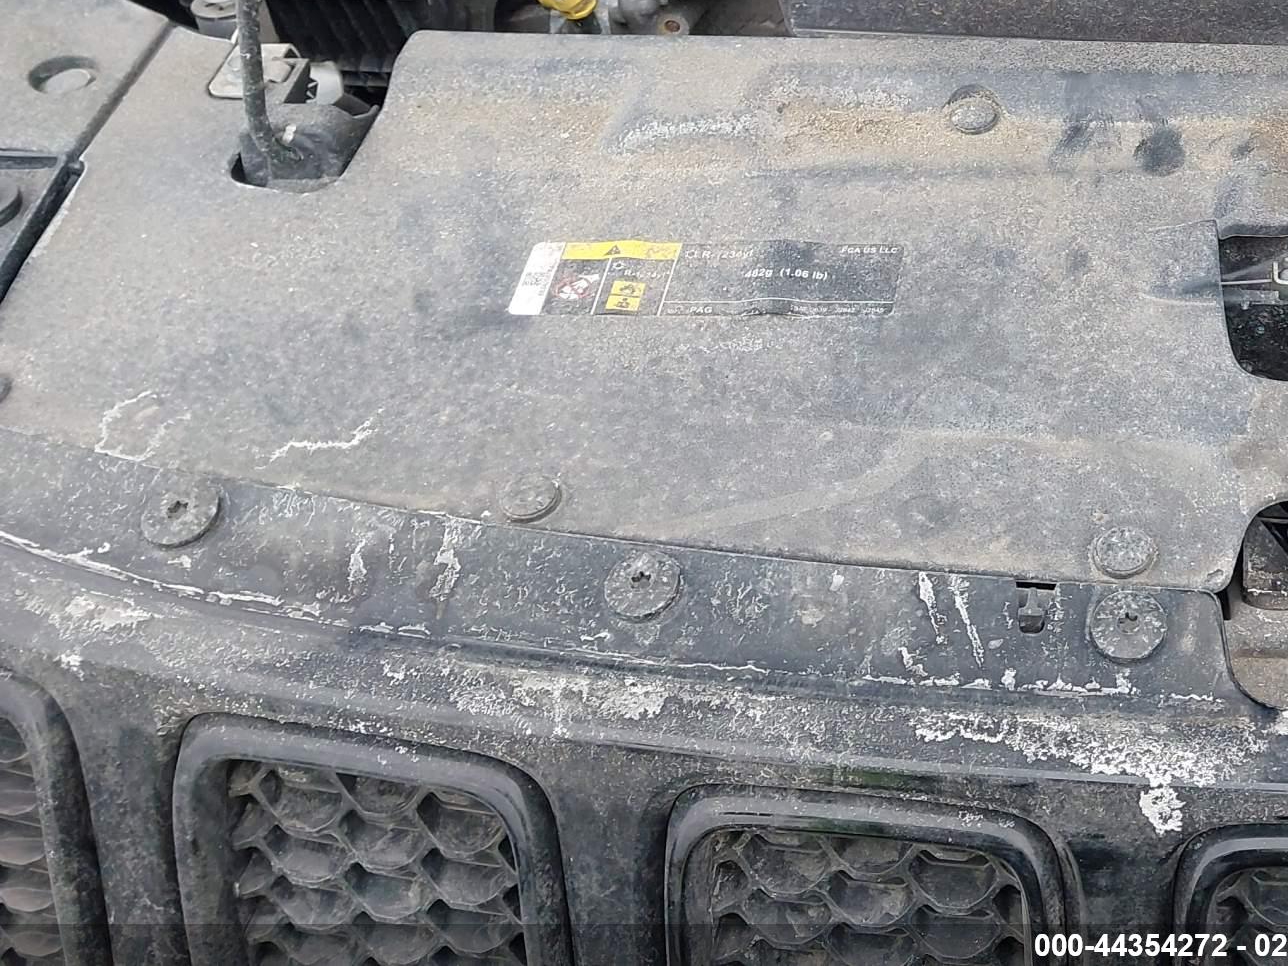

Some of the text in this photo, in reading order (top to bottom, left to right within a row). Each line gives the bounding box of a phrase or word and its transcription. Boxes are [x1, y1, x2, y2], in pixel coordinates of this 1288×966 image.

[863, 246, 877, 254] US
[879, 244, 898, 254] LLC
[779, 267, 810, 280] (1.06
[812, 270, 829, 281] lb)
[689, 305, 713, 314] PAG
